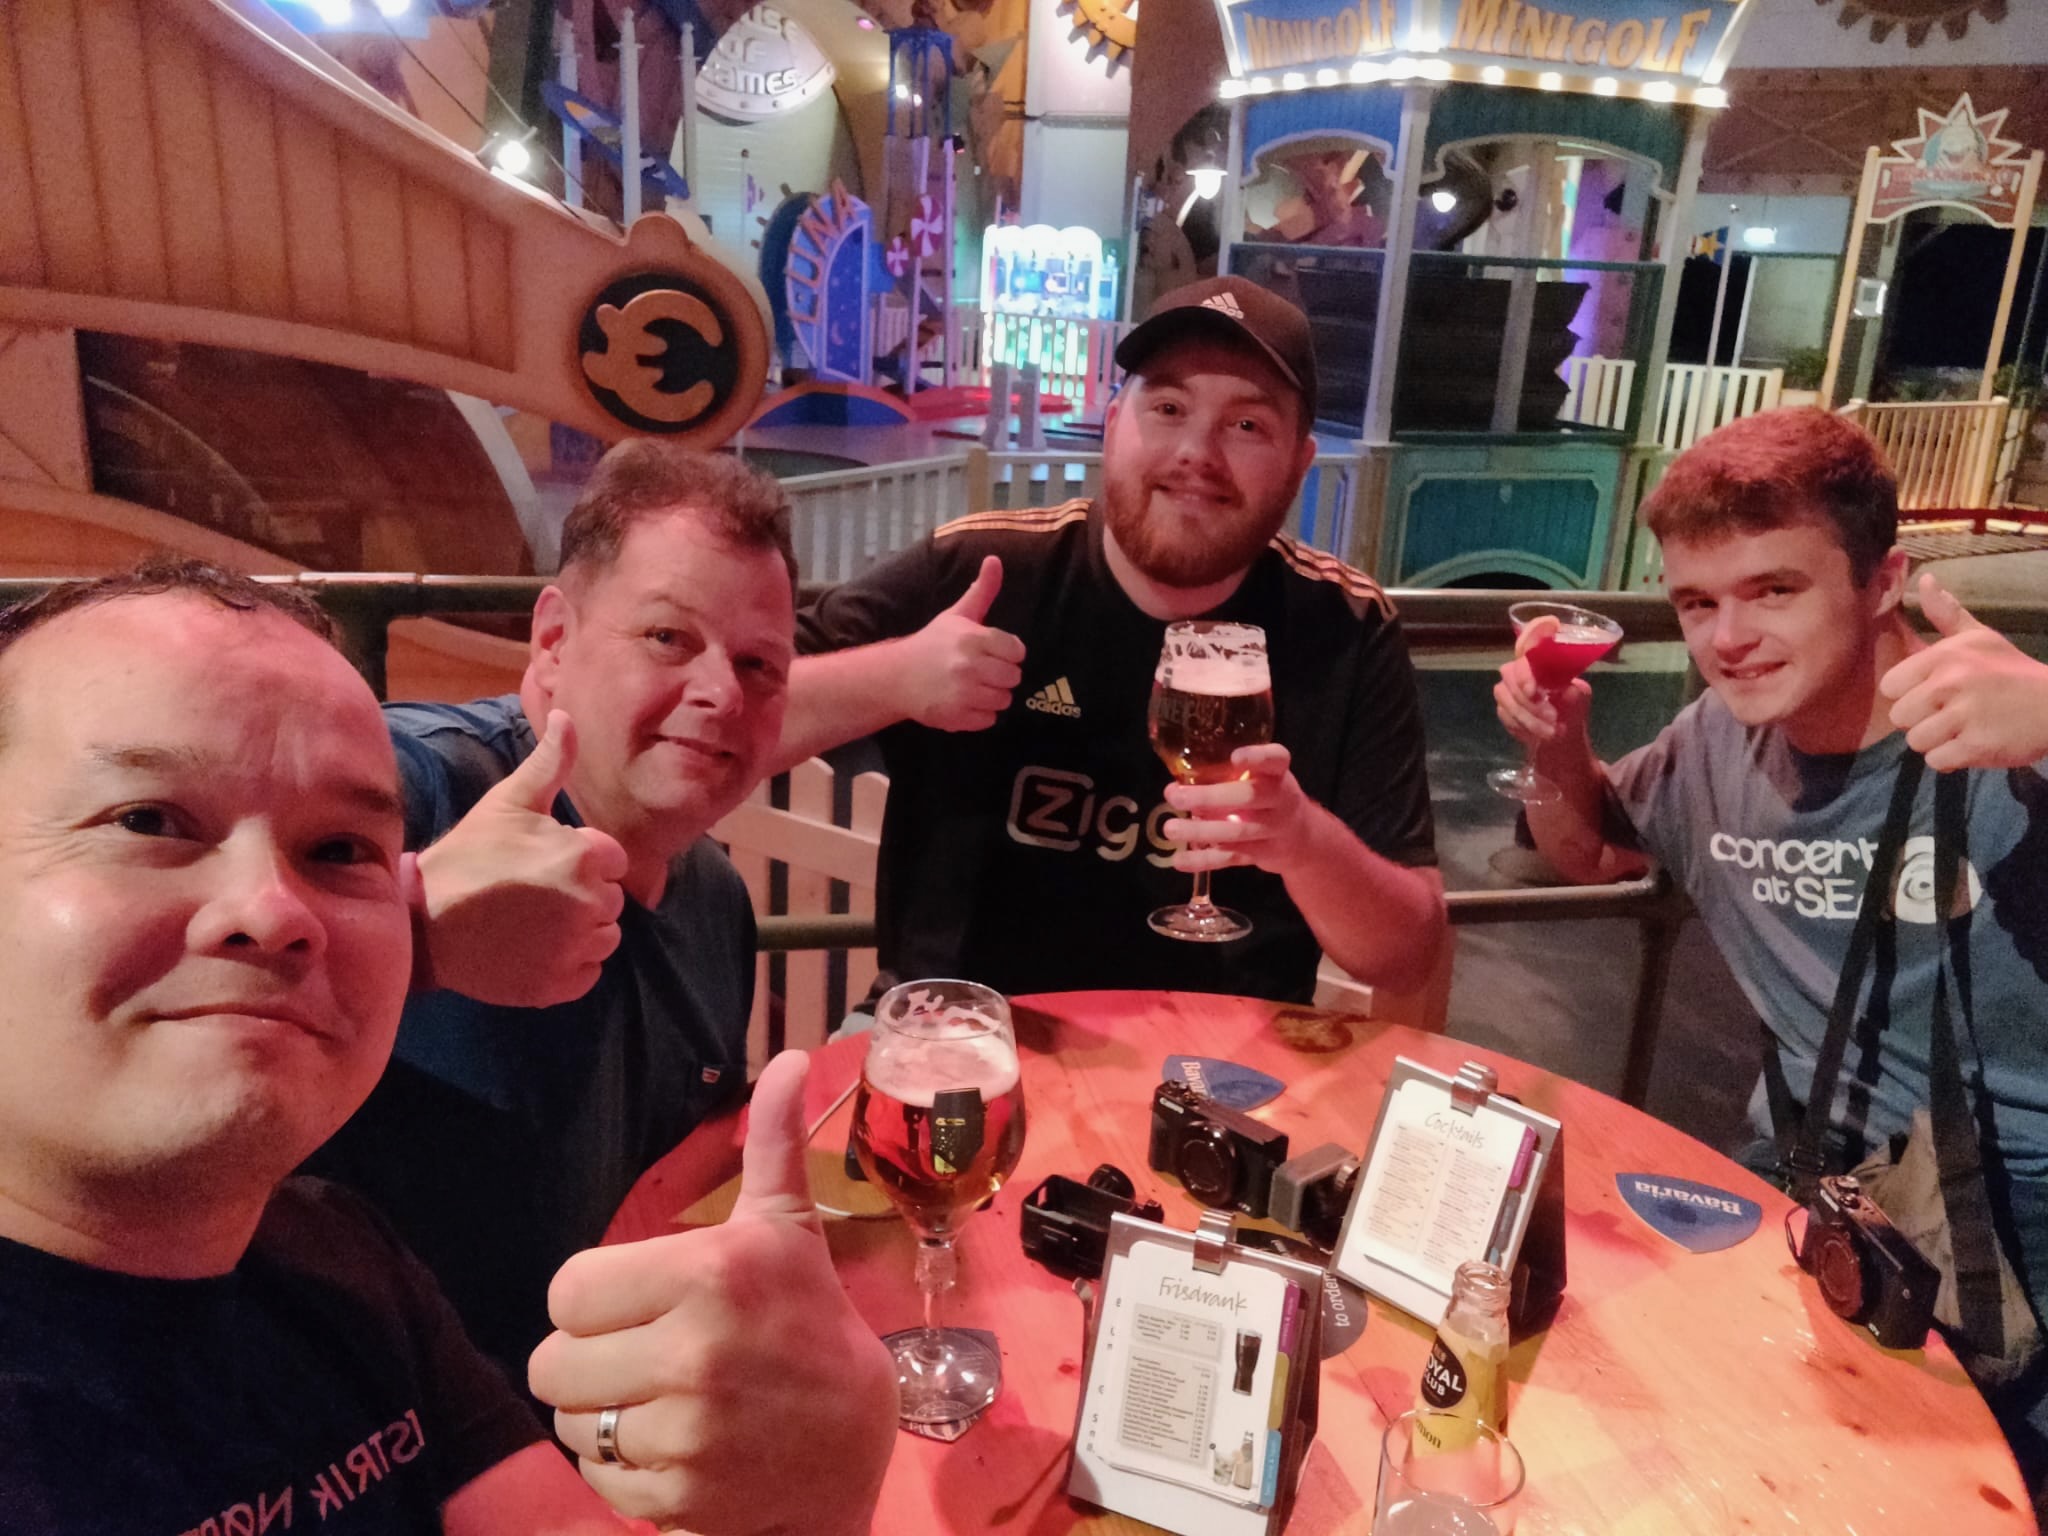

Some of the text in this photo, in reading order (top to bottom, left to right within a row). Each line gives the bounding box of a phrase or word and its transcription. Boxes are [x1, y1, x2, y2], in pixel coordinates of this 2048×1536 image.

[1243, 0, 1396, 64] MINIGOLF
[1450, 0, 1712, 72] MINIGOLF
[1025, 697, 1082, 719] adidas
[1012, 768, 1188, 869] Zigg
[1752, 876, 1865, 919] at SE
[1634, 1180, 1743, 1216] Bavaria
[1158, 1276, 1249, 1317] Frisdrank
[1334, 1307, 1350, 1328] to
[1424, 1350, 1463, 1393] OYAL
